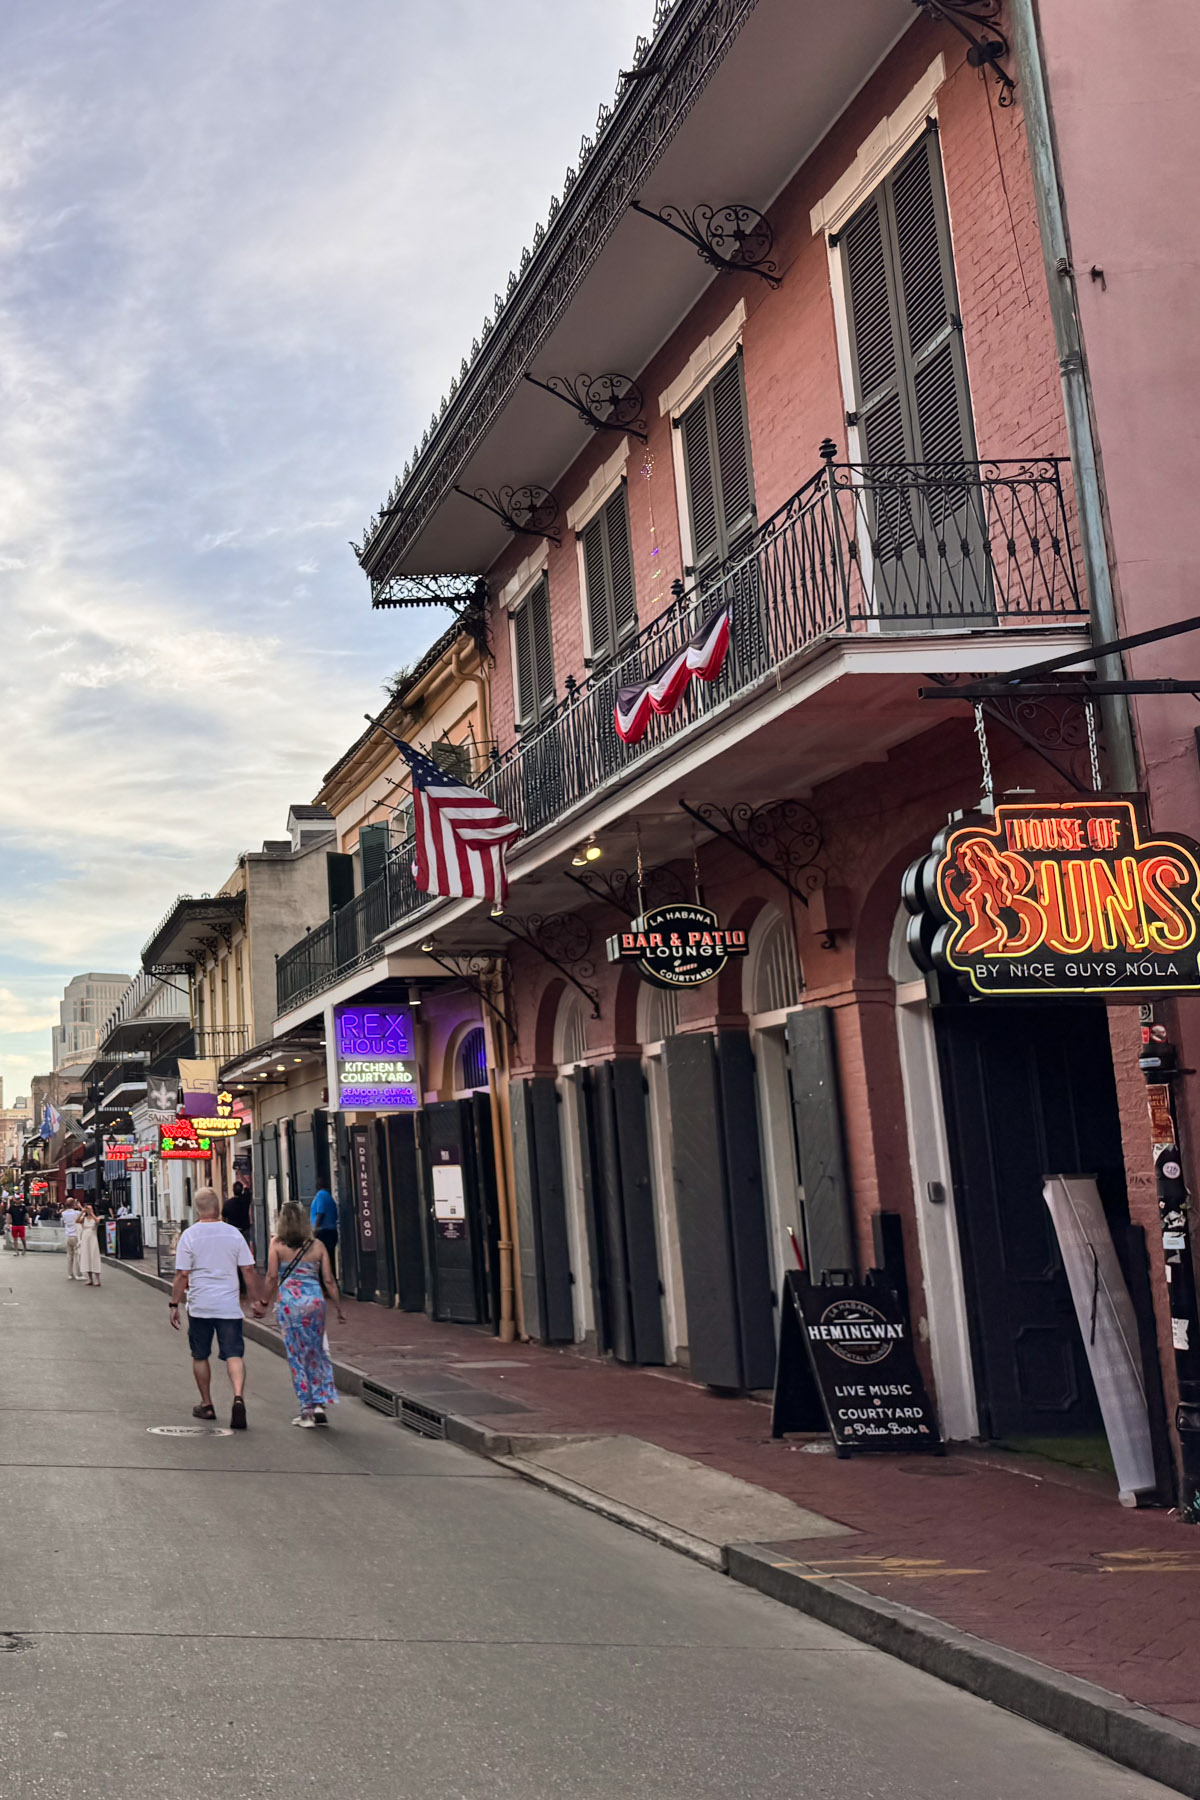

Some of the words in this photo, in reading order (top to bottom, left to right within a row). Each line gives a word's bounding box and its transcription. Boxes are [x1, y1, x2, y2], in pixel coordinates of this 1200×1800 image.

[1005, 818, 1084, 852] HOUSE
[1086, 817, 1121, 852] OF
[955, 842, 1196, 957] BUNS
[649, 915, 664, 926] LA
[666, 911, 711, 925] HABANA
[622, 933, 663, 948] BAR
[670, 932, 682, 946] &
[688, 931, 746, 946] PATIO
[646, 945, 725, 958] LOUNGE
[659, 968, 714, 982] COURTYARD
[976, 963, 1001, 977] BY
[1010, 963, 1055, 977] NICE
[1065, 962, 1117, 976] GUYS
[1126, 962, 1179, 976] NOLA
[341, 1014, 404, 1038] REX
[341, 1039, 409, 1054] HOUSE
[345, 1062, 394, 1072] KITCHEN
[396, 1062, 405, 1071] &
[340, 1073, 412, 1083] COURTYARD
[343, 1088, 378, 1096] SEAFOOD
[191, 1117, 242, 1129] TRUMPET
[359, 1147, 369, 1196] DRINKS
[362, 1201, 371, 1217] TO
[363, 1221, 372, 1237] GO
[828, 1307, 839, 1318] LA
[838, 1302, 874, 1317] HABANA
[808, 1324, 904, 1340] HEMINGWAY
[834, 1385, 866, 1397] LIVE
[869, 1384, 912, 1396] MUSIC
[838, 1407, 923, 1420] COURTYARD
[853, 1422, 889, 1435] Patio
[888, 1422, 918, 1435] Bar
